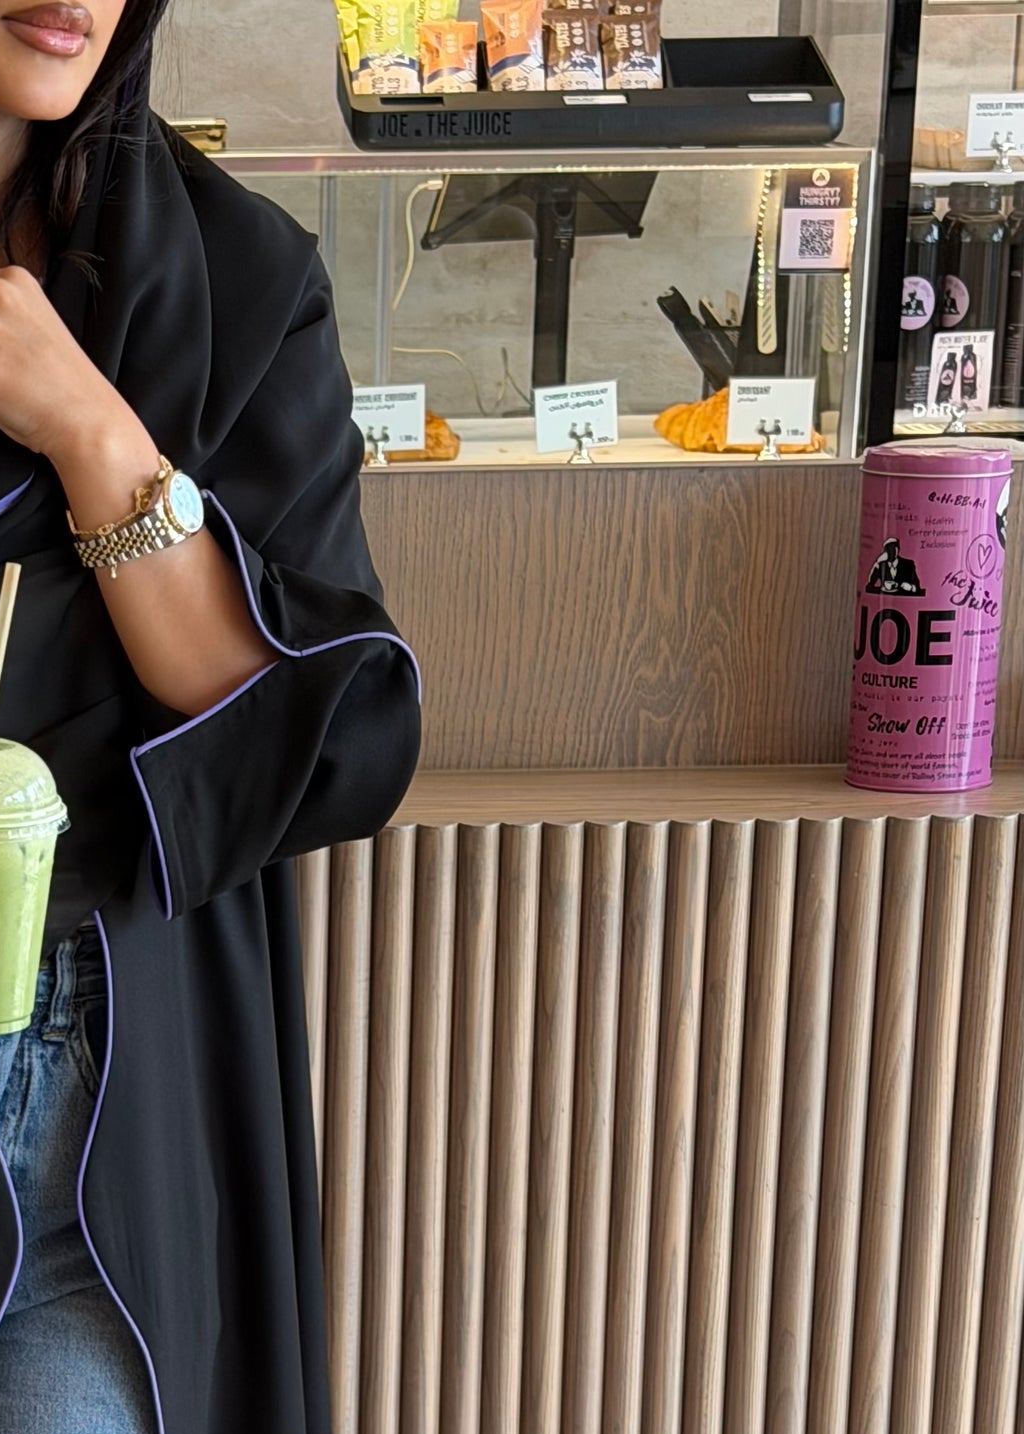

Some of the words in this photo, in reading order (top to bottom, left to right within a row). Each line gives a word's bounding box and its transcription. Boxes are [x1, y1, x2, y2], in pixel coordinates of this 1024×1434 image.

[378, 112, 408, 137] JOE
[427, 113, 458, 137] THE
[463, 111, 512, 136] JUICE
[799, 197, 840, 206] THIRSTY?
[854, 605, 957, 666] JOE
[861, 672, 919, 690] CULTURE
[867, 712, 912, 734] Show
[915, 715, 947, 736] Off
